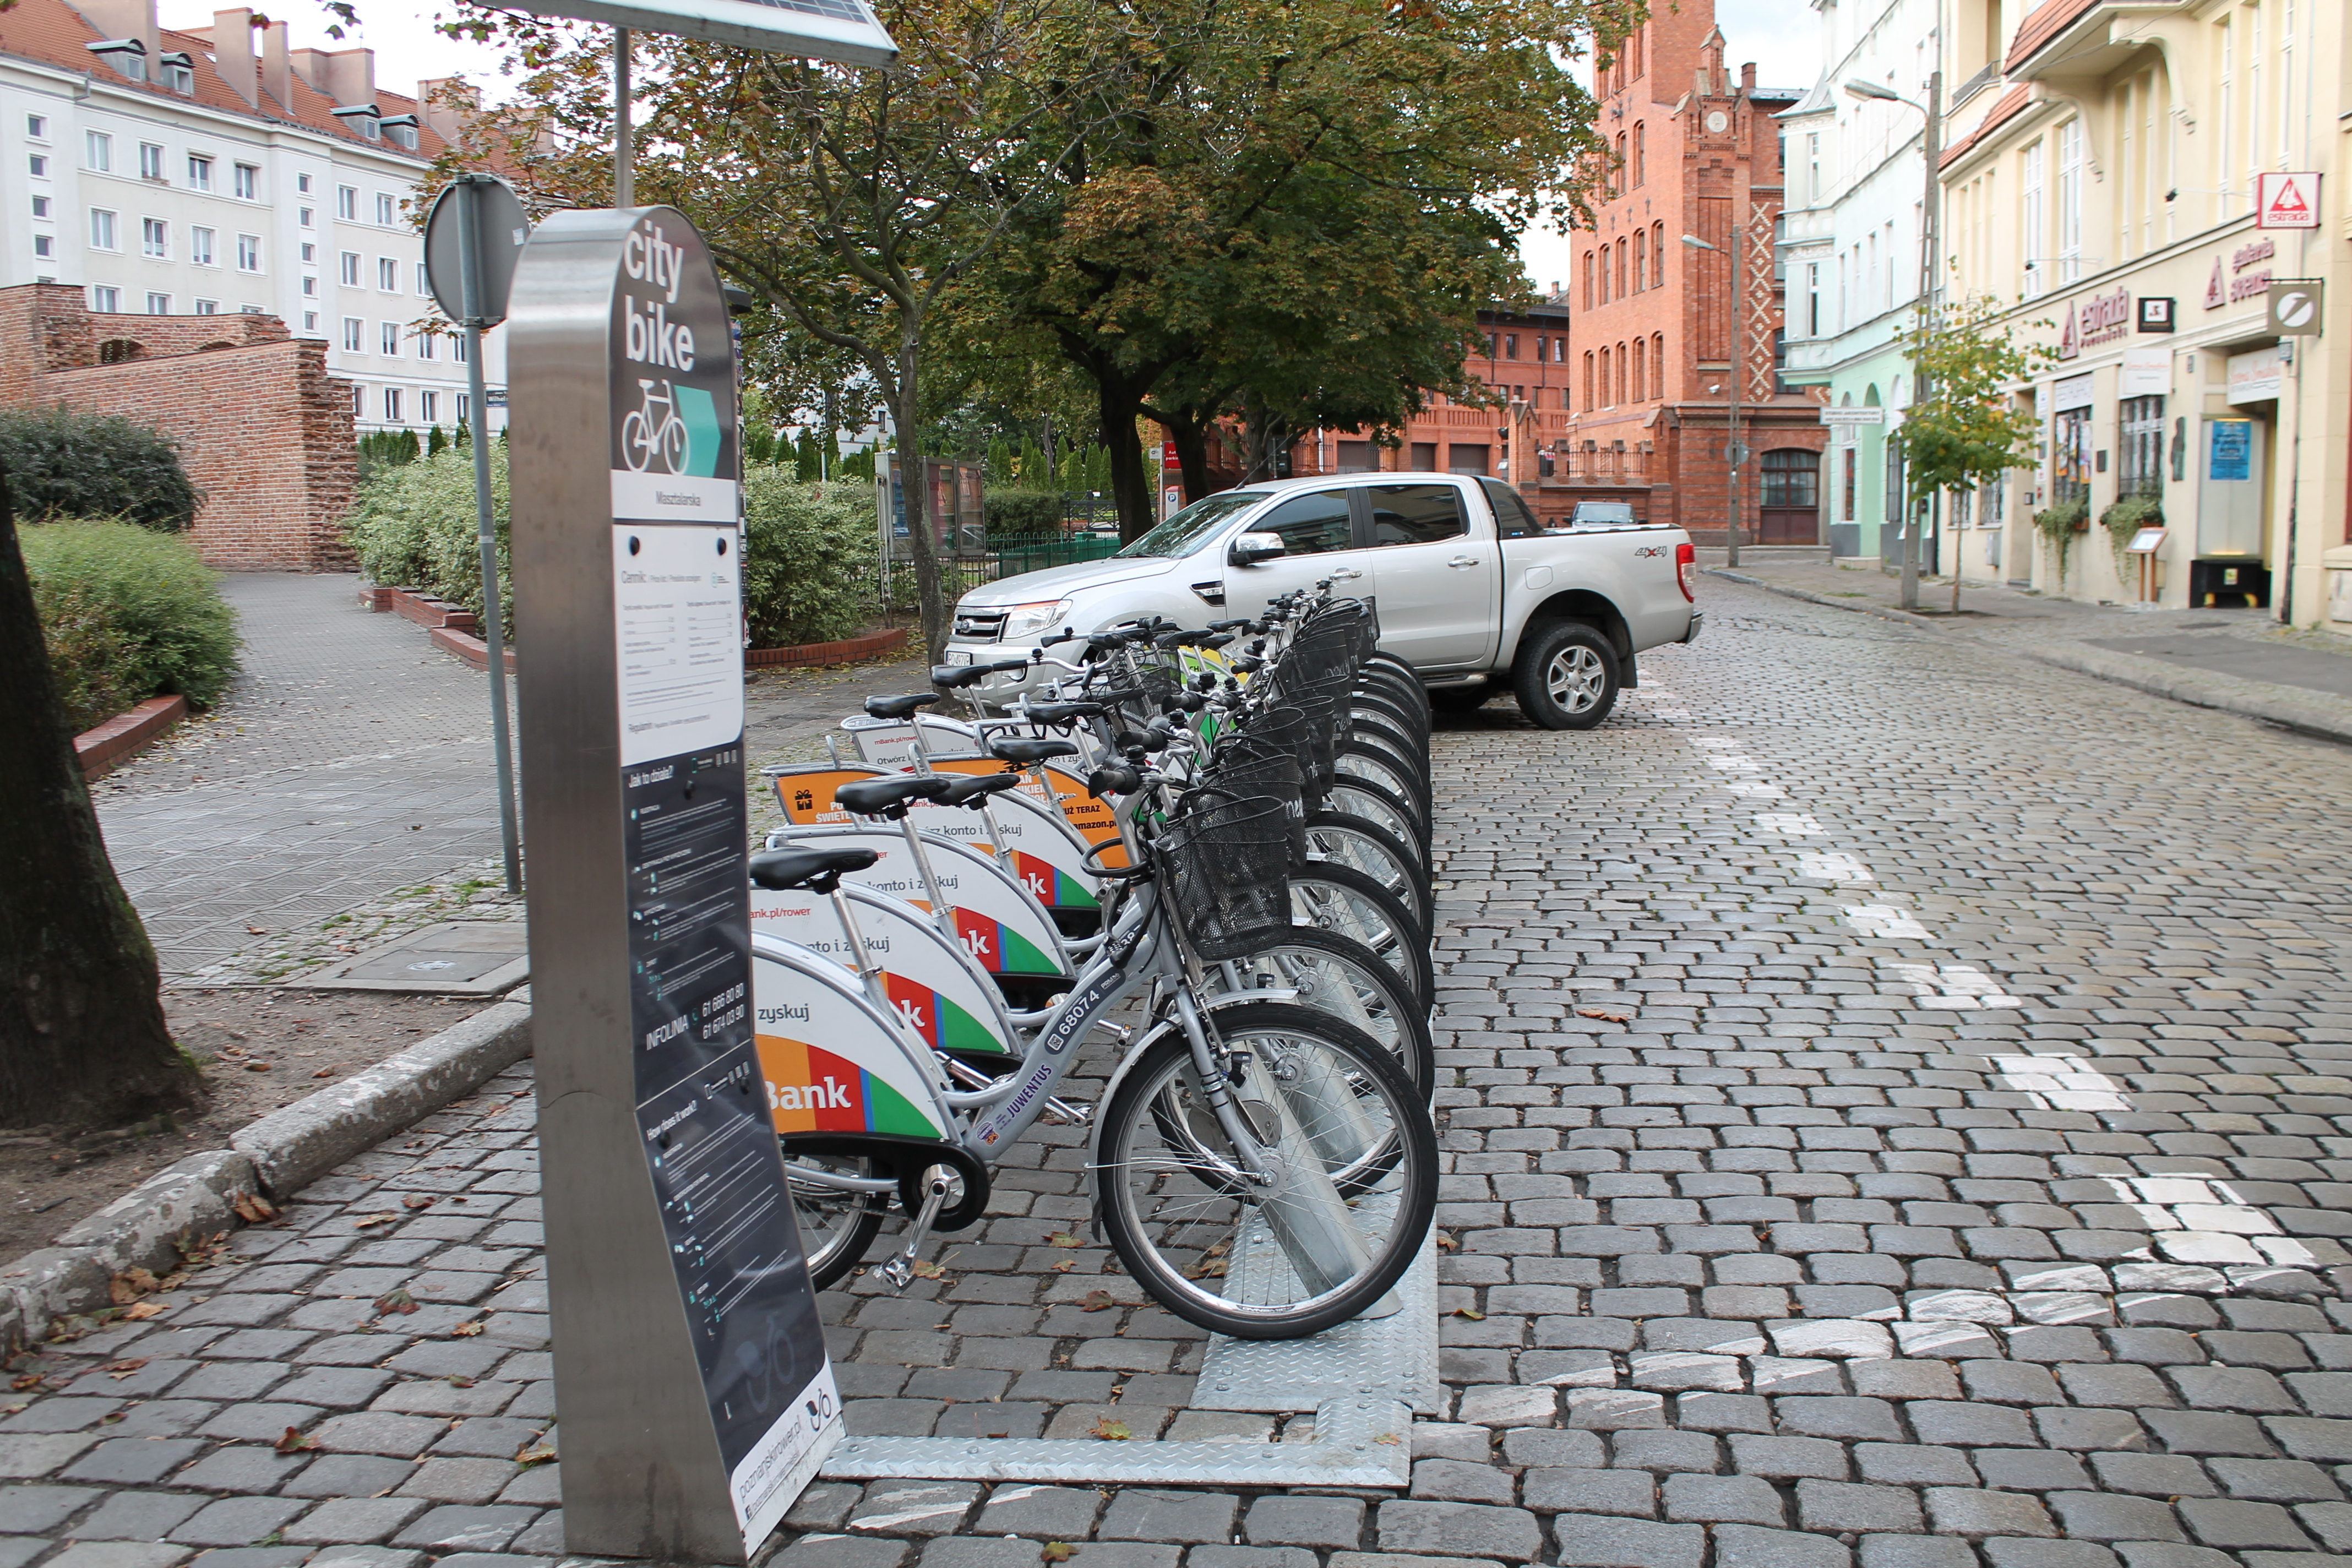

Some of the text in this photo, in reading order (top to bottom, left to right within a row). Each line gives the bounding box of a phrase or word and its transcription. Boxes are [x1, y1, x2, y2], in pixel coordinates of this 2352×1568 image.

[624, 219, 684, 303] city
[2081, 286, 2128, 335] estrada
[625, 295, 694, 372] bike
[656, 491, 701, 507] Masztalarska
[1635, 546, 1667, 558] 4x4
[874, 736, 918, 745] mBank.pl/rowe
[877, 755, 906, 765] Otwórz
[628, 774, 641, 788] Jak
[641, 772, 650, 784] to
[1076, 805, 1100, 814] TERAZ
[943, 825, 977, 836] konto
[979, 824, 983, 835] i
[909, 878, 913, 889] i
[834, 939, 839, 951] i
[703, 982, 744, 1017] 61 666 80 80
[758, 1003, 810, 1023] zyskuj
[1059, 990, 1100, 1036] 68074
[703, 1004, 744, 1039] 61 674 03 90
[646, 1014, 689, 1051] INFOLINIA
[1006, 1064, 1053, 1118] JUWENTUS
[986, 1133, 1000, 1146] GPS
